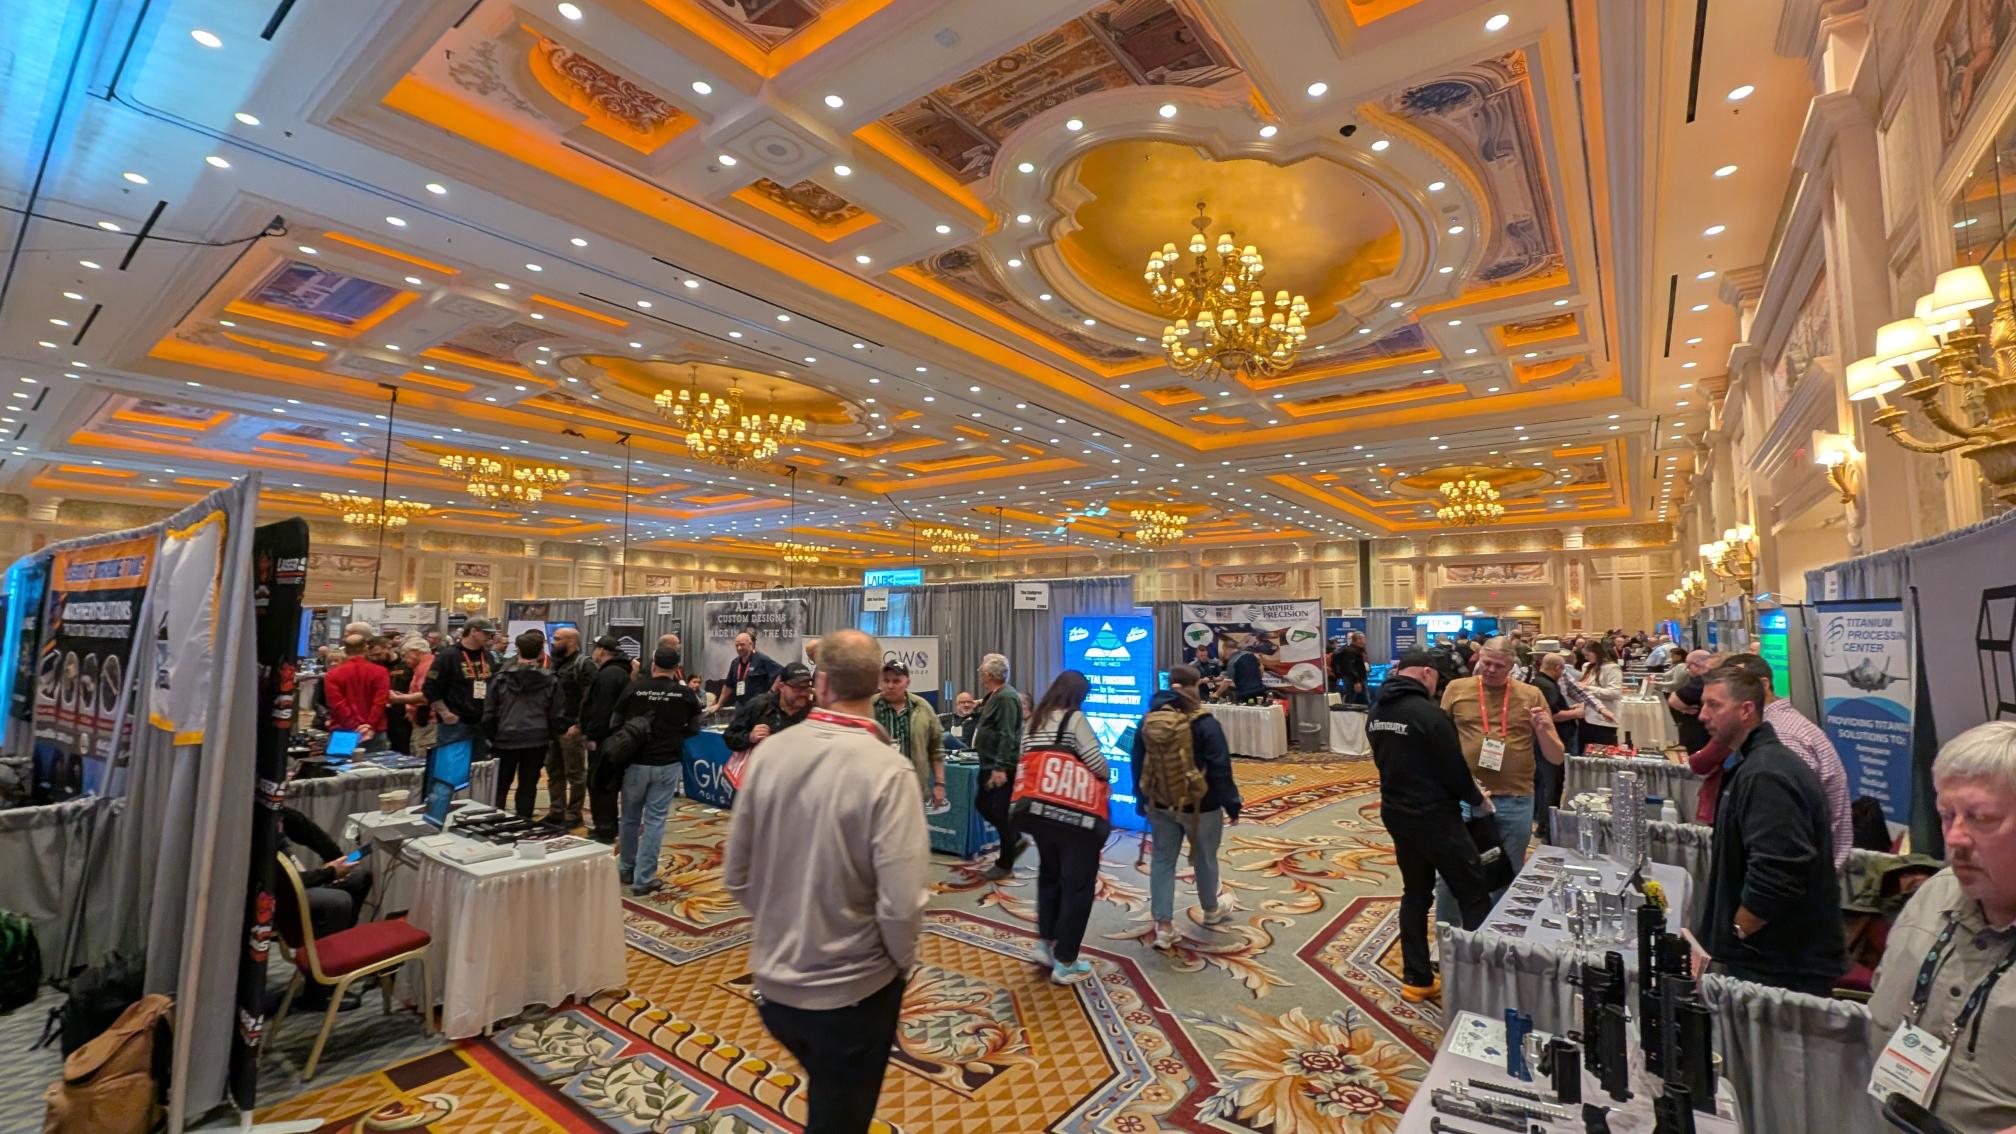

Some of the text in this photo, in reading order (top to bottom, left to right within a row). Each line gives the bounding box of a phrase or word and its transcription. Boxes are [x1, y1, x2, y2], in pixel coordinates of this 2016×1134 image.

[718, 613, 786, 623] CUSTOM DESIGNS
[1262, 610, 1309, 619] PRECISION
[1847, 618, 1893, 627] TITANIUM
[763, 629, 780, 638] THE
[782, 629, 799, 638] USA
[1843, 642, 1884, 653] CENTER
[1108, 694, 1141, 705] INDUSTRY
[1838, 729, 1889, 743] SOLUTIONS
[1041, 757, 1089, 803] SAR
